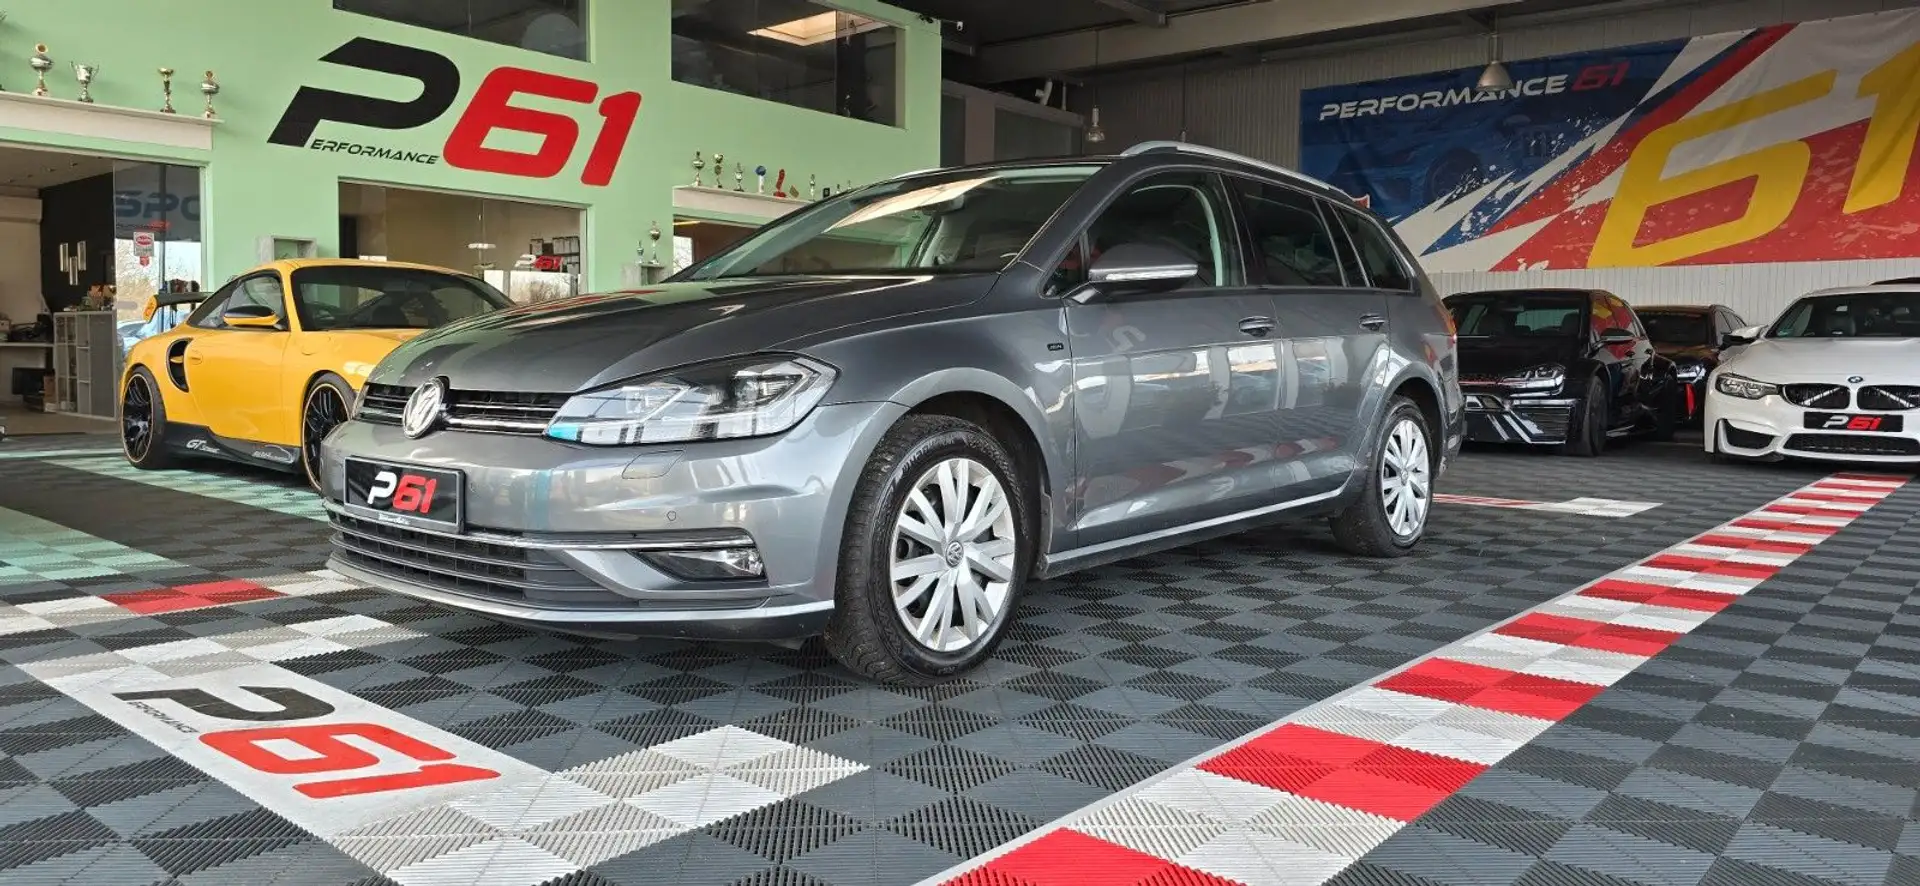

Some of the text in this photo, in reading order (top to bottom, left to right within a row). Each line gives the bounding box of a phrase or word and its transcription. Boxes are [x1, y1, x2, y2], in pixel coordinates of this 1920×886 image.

[267, 37, 642, 186] P61
[1572, 61, 1631, 92] 61
[1587, 39, 1920, 268] 61
[1822, 415, 1882, 431] P61
[367, 470, 437, 514] P61
[111, 686, 502, 799] P61
